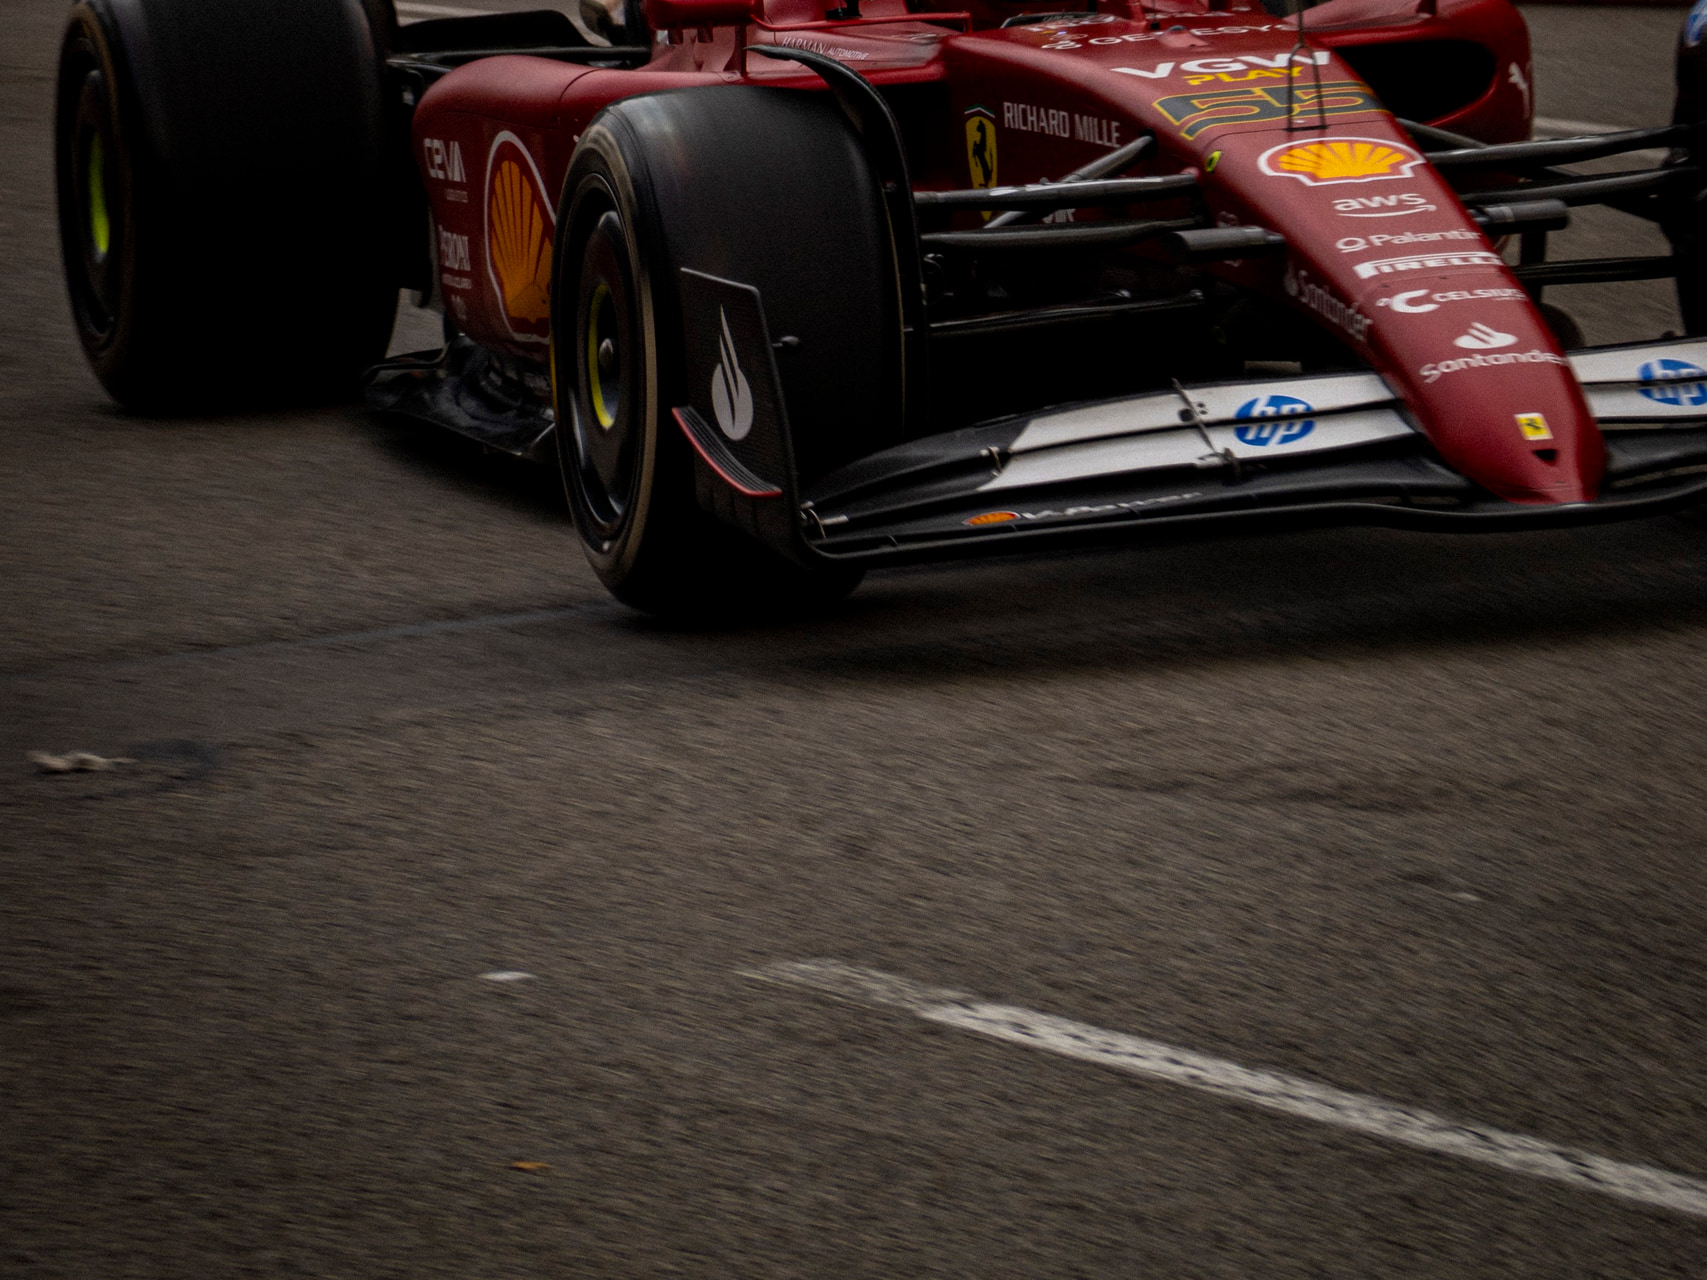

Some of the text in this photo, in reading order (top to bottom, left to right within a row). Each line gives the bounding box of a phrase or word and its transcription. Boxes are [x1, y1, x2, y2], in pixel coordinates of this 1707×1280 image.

[781, 36, 826, 56] HARMAN
[1110, 50, 1331, 79] VGW
[1182, 67, 1303, 86] PLAY
[1002, 101, 1122, 149] RICHARD MILLE
[1152, 80, 1390, 141] 55
[1332, 193, 1428, 212] aws
[1245, 395, 1306, 446] hp
